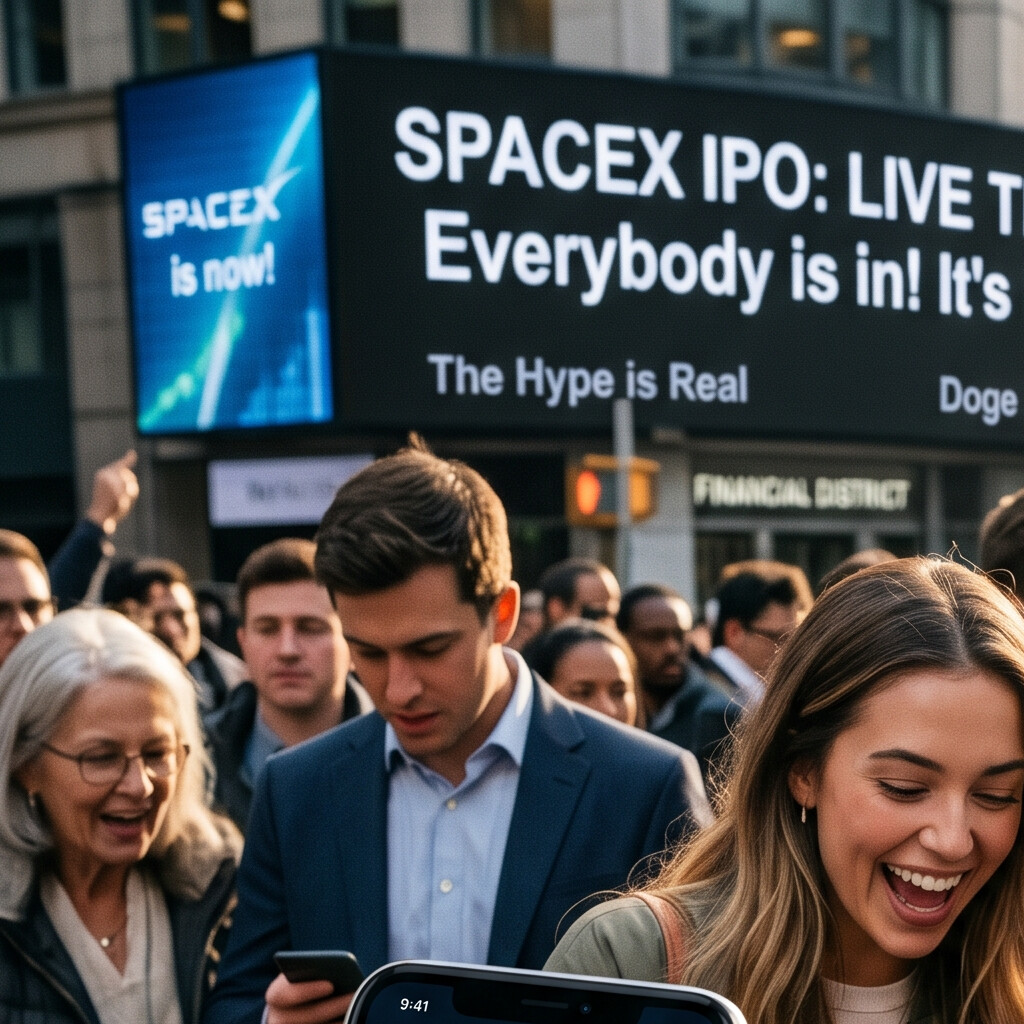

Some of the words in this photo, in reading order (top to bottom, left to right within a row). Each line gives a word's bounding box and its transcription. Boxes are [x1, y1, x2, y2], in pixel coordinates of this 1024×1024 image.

[394, 106, 686, 200] SPACEX
[702, 133, 829, 213] IPO:
[848, 151, 974, 231] LIVE
[142, 166, 301, 239] SPACEX
[170, 254, 197, 297] is
[203, 241, 275, 293] now!
[424, 208, 774, 316] Everybody
[790, 233, 841, 304] is
[854, 240, 922, 313] in!
[938, 250, 1013, 322] It's
[428, 353, 505, 396] The
[515, 356, 615, 408] Hype
[626, 360, 658, 400] is
[669, 362, 748, 404] Real
[939, 374, 1018, 426] Doge
[399, 998, 429, 1013] 9:41
